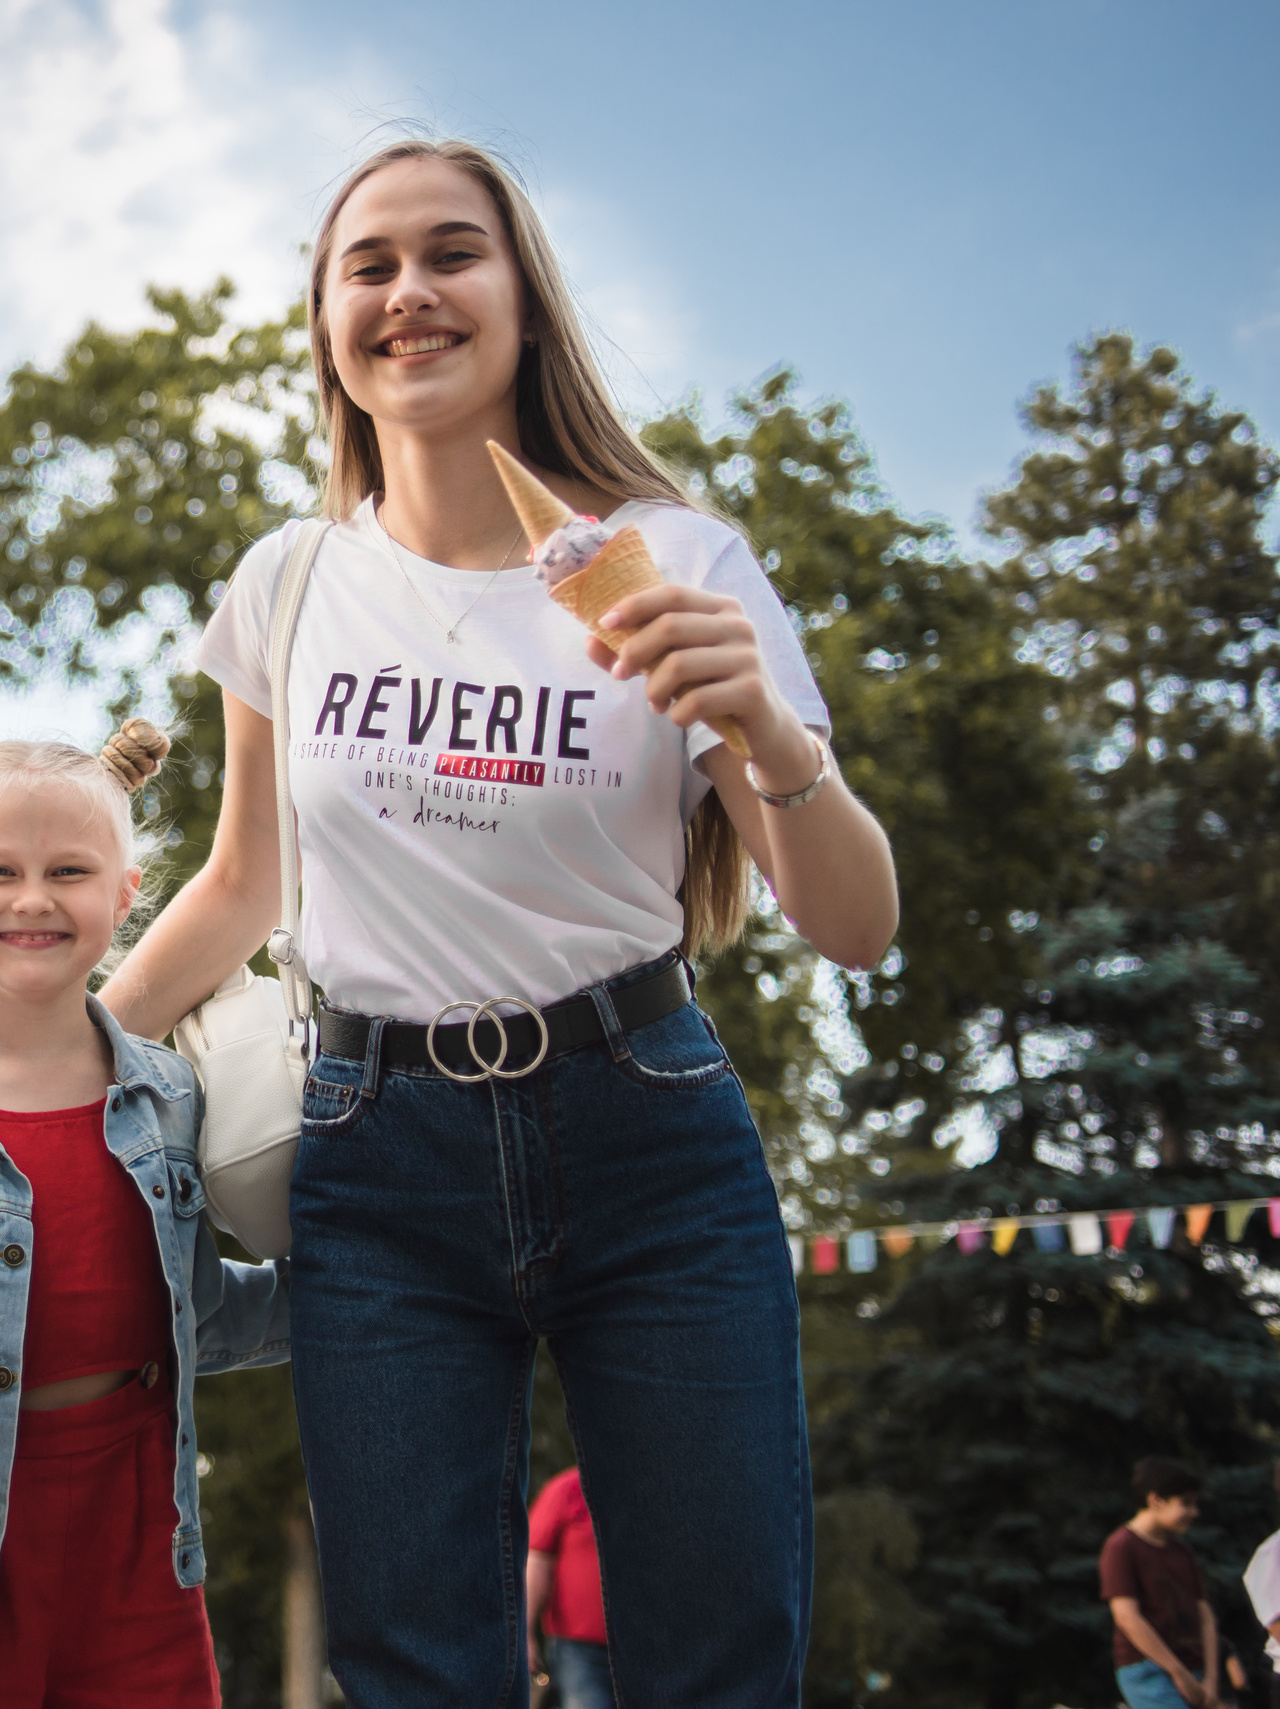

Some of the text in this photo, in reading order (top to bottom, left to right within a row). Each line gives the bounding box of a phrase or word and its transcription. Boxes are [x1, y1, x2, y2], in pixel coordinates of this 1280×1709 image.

[314, 664, 596, 761] RÉVERIE
[300, 742, 338, 759] STATE
[347, 744, 367, 761] OF
[377, 746, 429, 768] BEING
[438, 757, 541, 783] PLEASANTLY
[554, 766, 597, 786] LOST
[607, 771, 622, 788] IN
[365, 770, 413, 791] ONE'S
[378, 795, 501, 833] a dreamer
